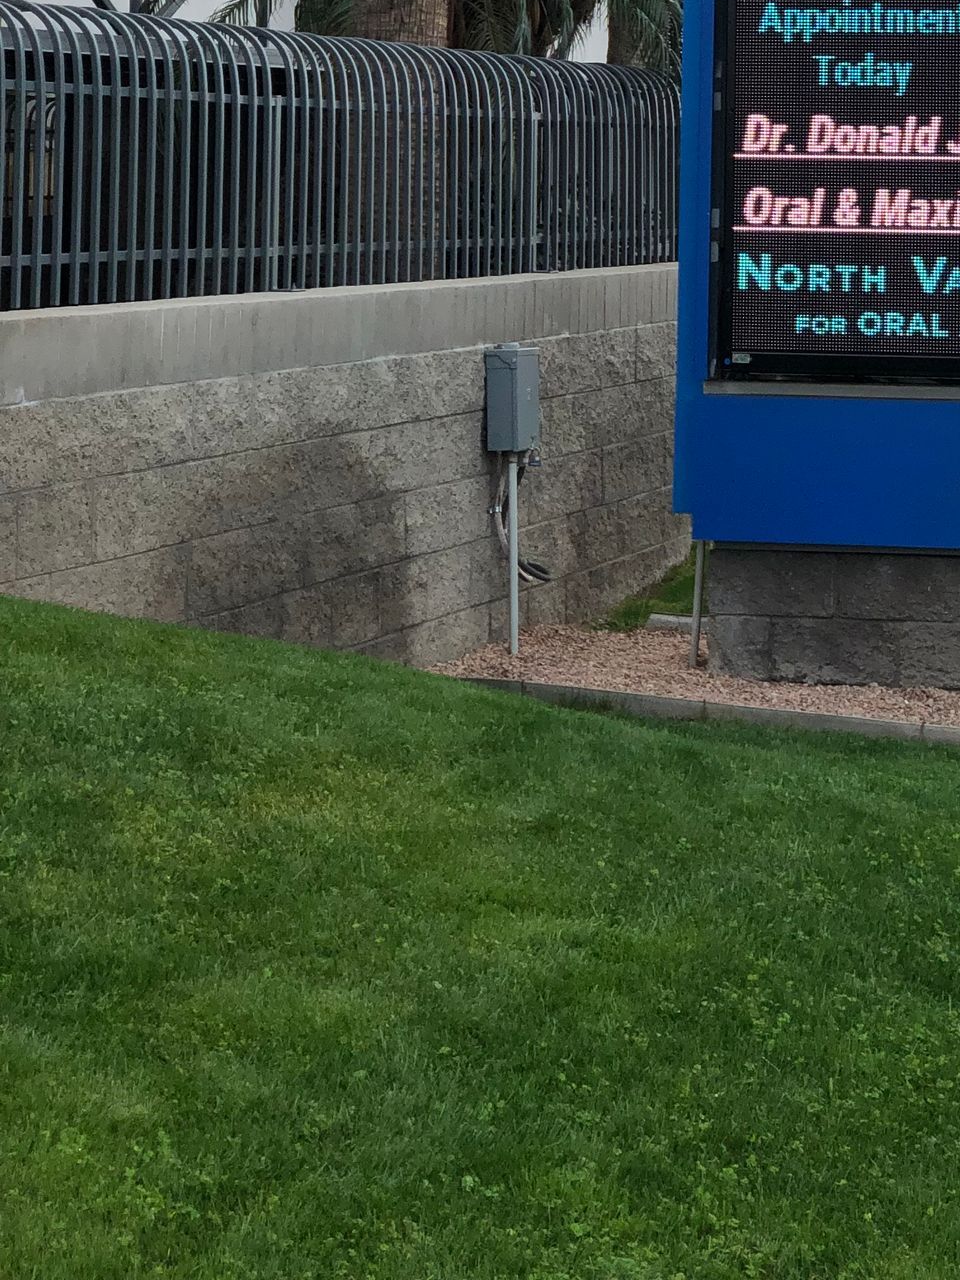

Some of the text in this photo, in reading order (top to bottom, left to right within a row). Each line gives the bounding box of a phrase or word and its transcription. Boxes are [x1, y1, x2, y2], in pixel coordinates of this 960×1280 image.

[812, 52, 913, 96] Today
[742, 114, 796, 152] Dr.
[807, 114, 942, 154] Donald
[743, 186, 827, 225] Oral
[833, 187, 861, 226] &
[736, 251, 887, 293] NORTH
[795, 313, 848, 335] FOR
[857, 311, 949, 337] ORAL
